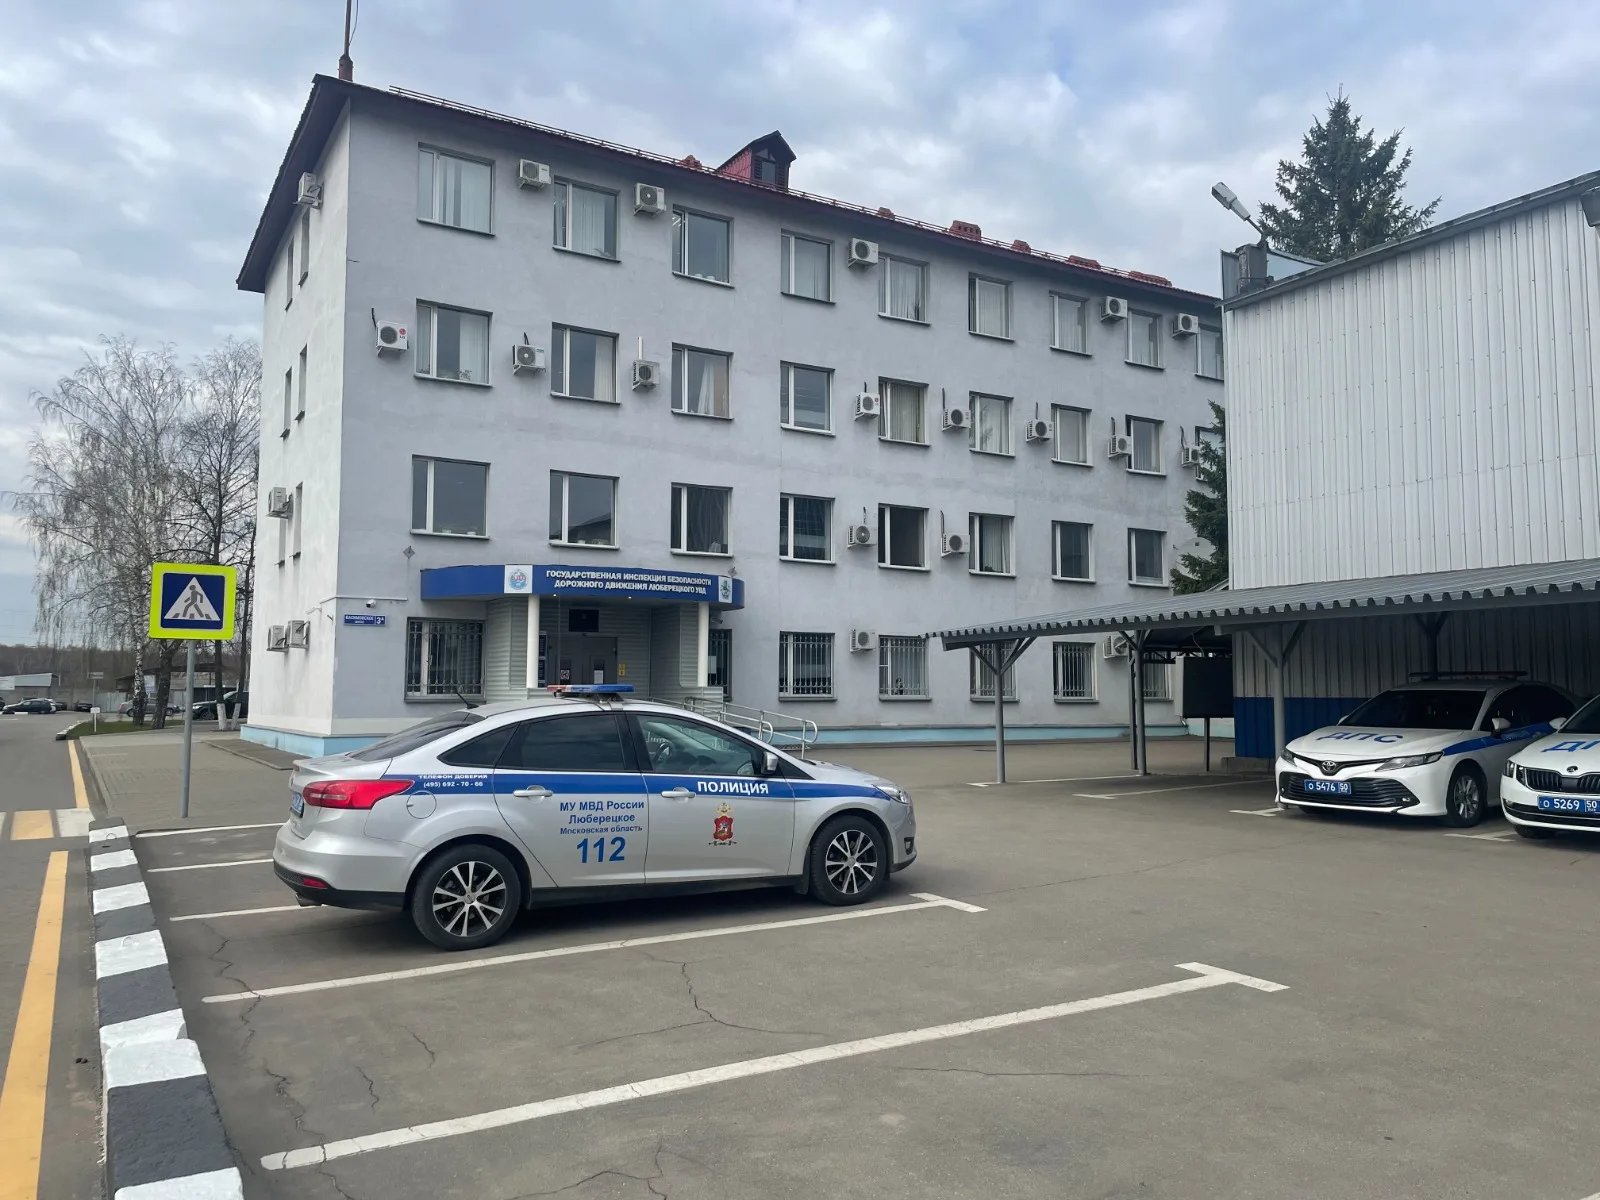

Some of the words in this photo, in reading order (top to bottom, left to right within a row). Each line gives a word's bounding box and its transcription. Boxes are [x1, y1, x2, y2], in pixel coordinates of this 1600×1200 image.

[546, 570, 622, 580] ГОСУДАРСТВЕННАЯ
[623, 572, 667, 582] ИНСПЕКЦИЯ
[667, 575, 712, 586] БЕЗОПАСНОСТИ
[554, 580, 604, 589] ДОРОЖНОГО
[604, 582, 648, 590] ДВИЖЕНИЯ
[648, 583, 695, 594] ЛЮБЕРЕЦКОГО
[695, 587, 707, 595] УВД
[1315, 732, 1404, 744] ДПС
[697, 781, 769, 796] ПОЛИЦИЯ
[1315, 781, 1336, 791] 5476
[560, 802, 576, 811] МУ
[579, 801, 604, 811] МВД
[606, 801, 645, 809] России
[1553, 798, 1580, 810] 5269
[1586, 800, 1598, 809] 50
[568, 814, 635, 825] Люберецкое
[560, 827, 609, 835] Московская
[610, 825, 643, 833] область
[576, 836, 626, 864] 112
